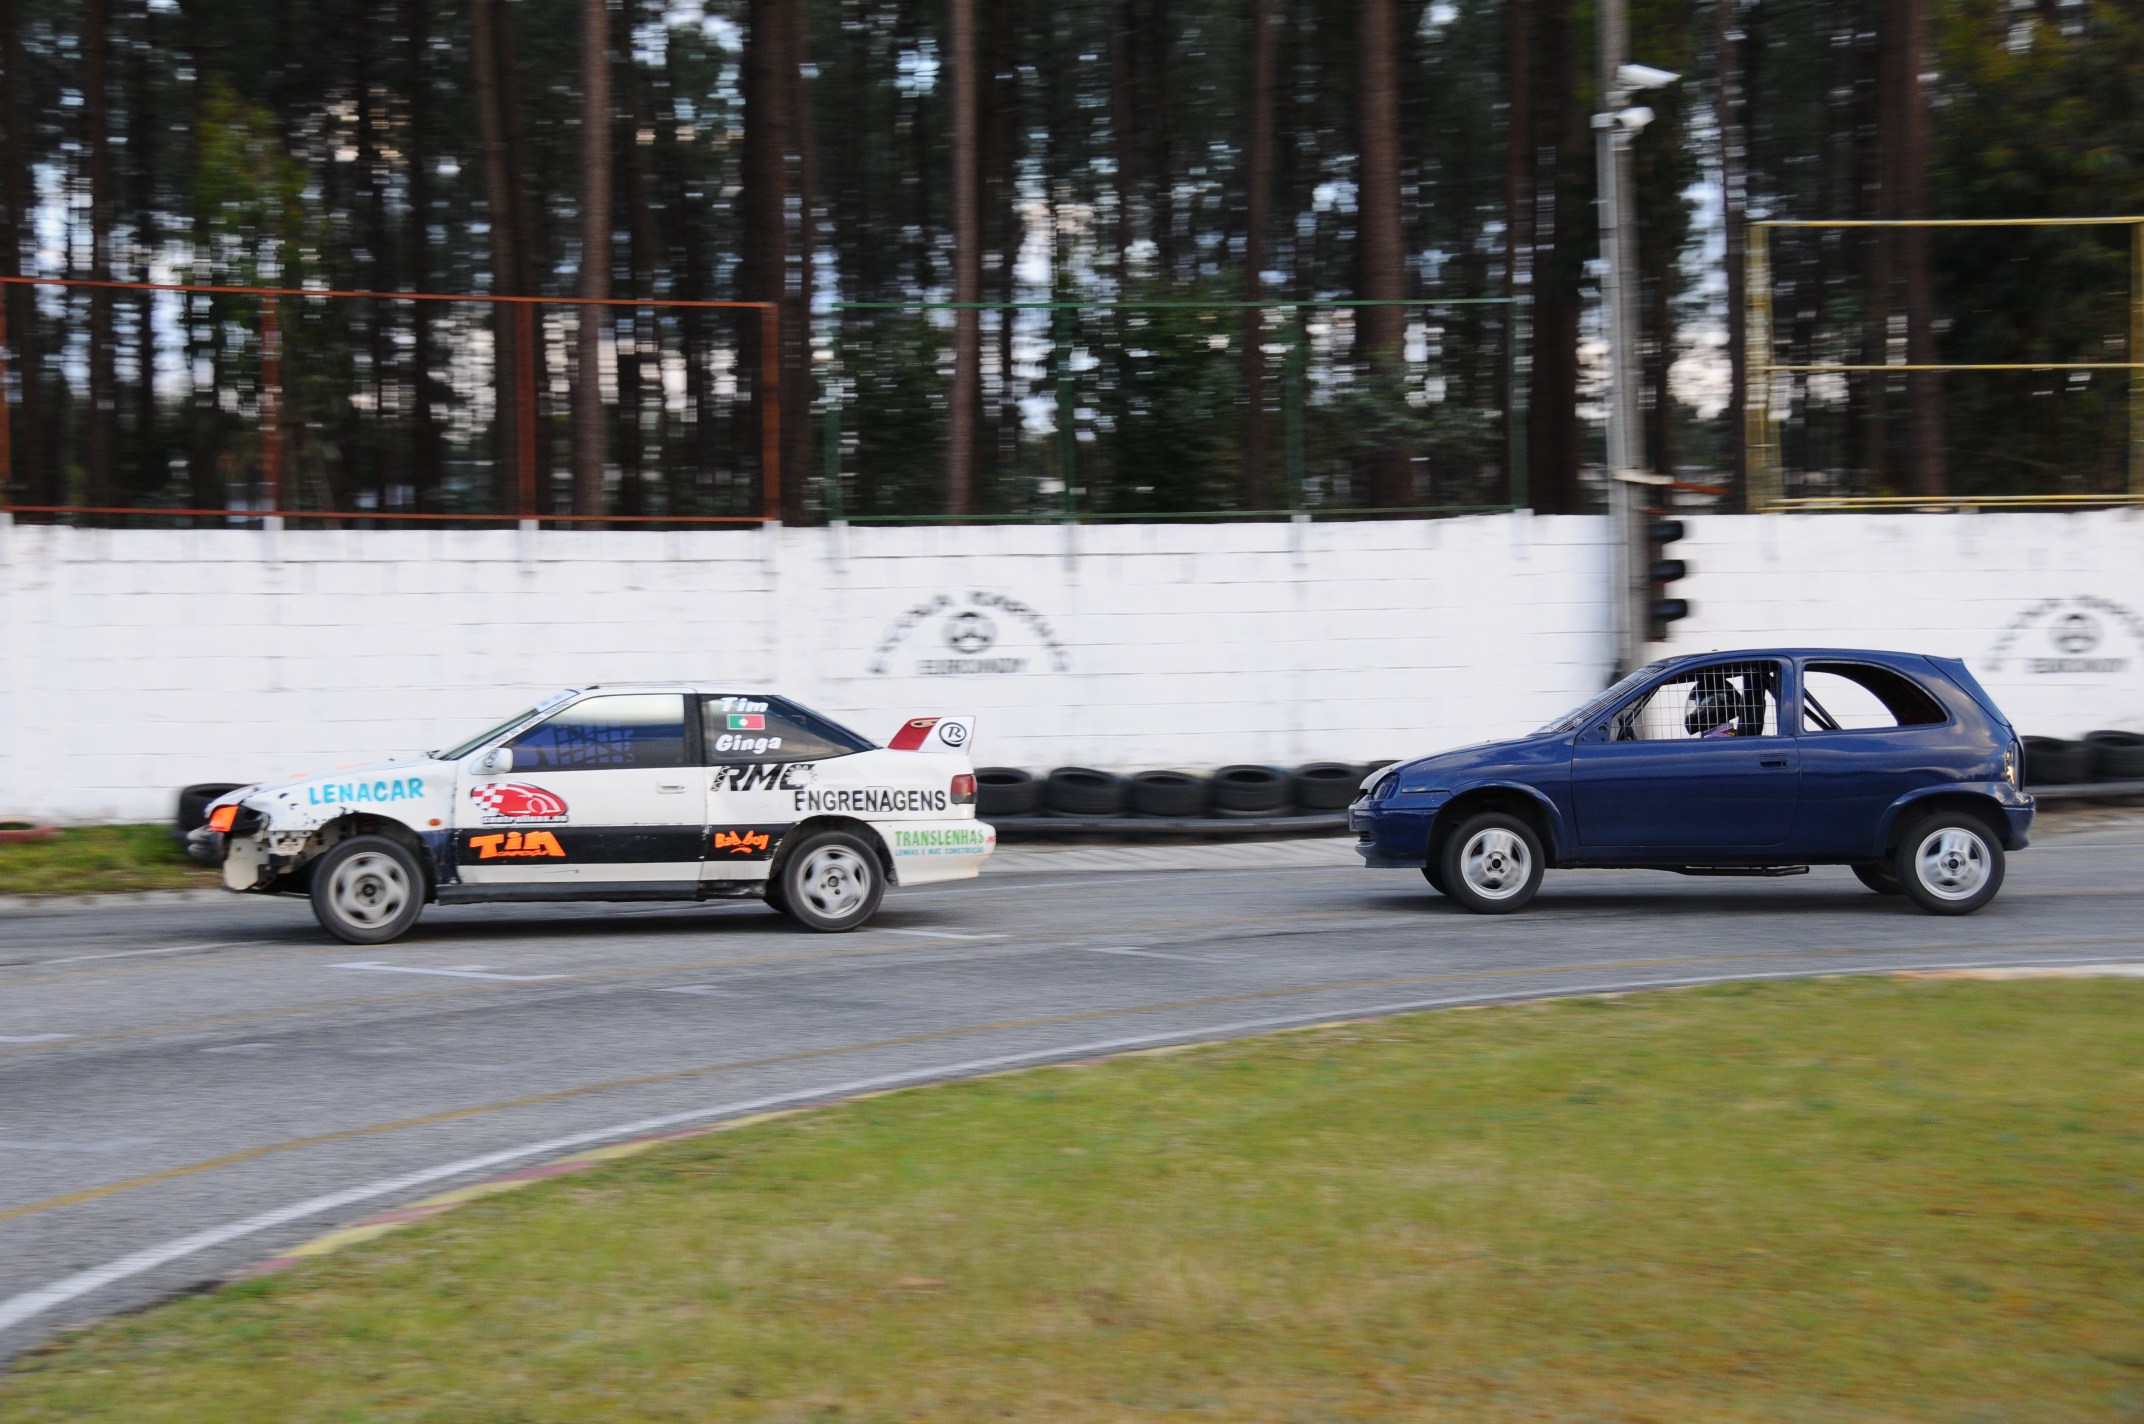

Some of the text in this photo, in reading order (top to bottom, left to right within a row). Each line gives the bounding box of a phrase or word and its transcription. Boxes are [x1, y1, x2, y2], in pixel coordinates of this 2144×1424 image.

[720, 697, 769, 712] Tim
[715, 734, 782, 755] Ginga
[308, 777, 424, 806] LENACAR
[795, 790, 946, 811] ENGRENAGENS
[895, 829, 985, 847] TRANSLENHAS
